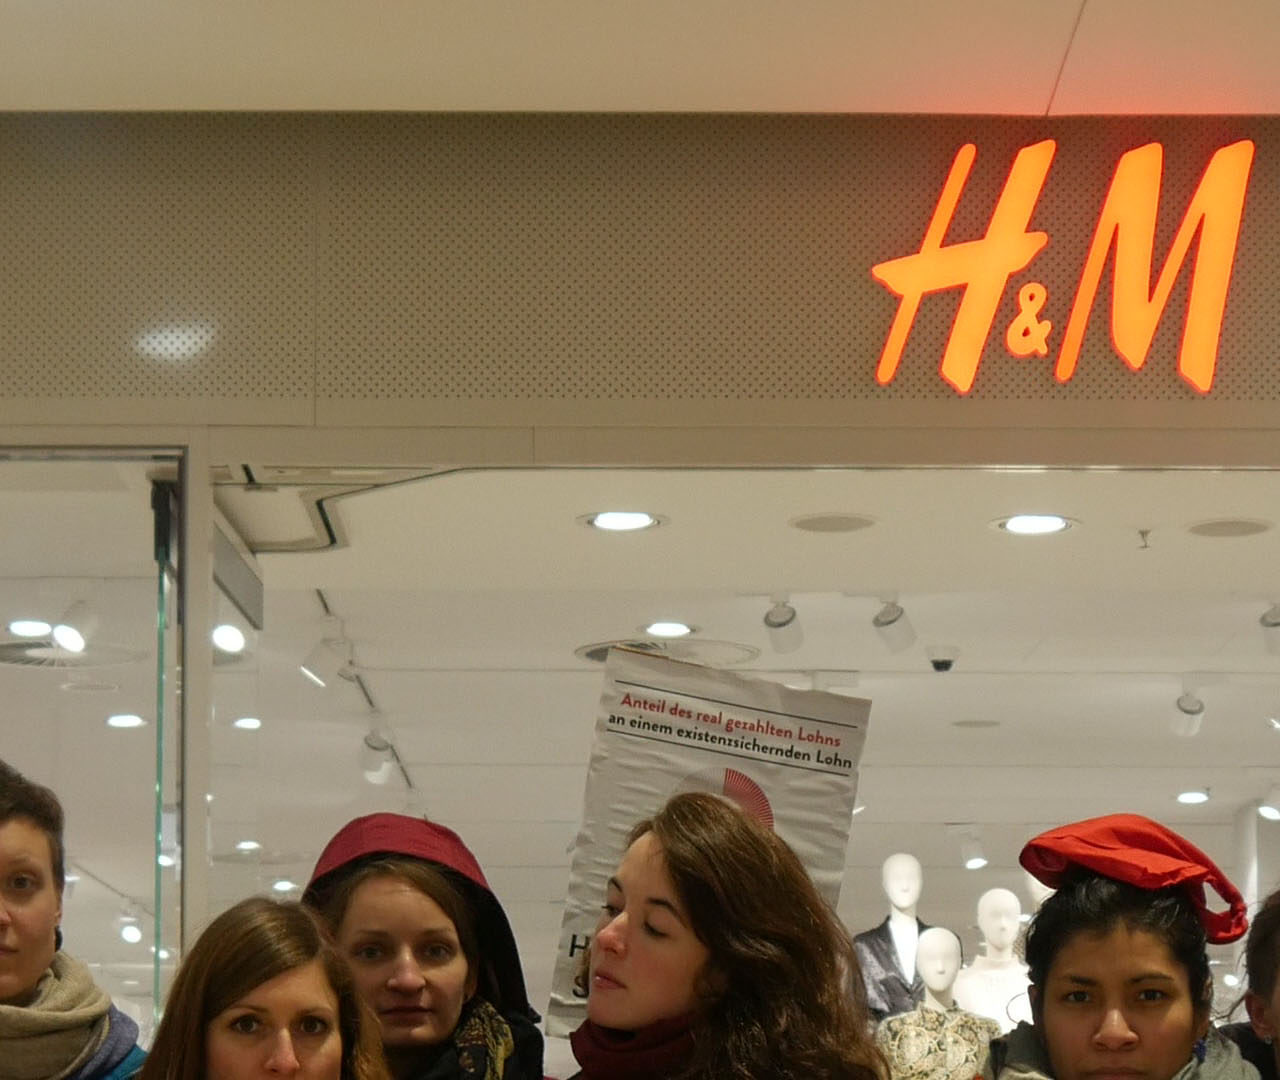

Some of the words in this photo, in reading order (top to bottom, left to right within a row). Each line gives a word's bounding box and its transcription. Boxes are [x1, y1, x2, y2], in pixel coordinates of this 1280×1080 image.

[871, 139, 1255, 393] H&M
[608, 713, 625, 726] an
[629, 715, 672, 735] einem
[676, 725, 811, 762] existenzsichernden
[815, 749, 852, 769] Lohn
[621, 693, 665, 713] Anteil
[669, 702, 692, 720] des
[696, 709, 721, 726] real
[725, 714, 793, 739] gezahlten
[797, 726, 841, 748] Lohns
